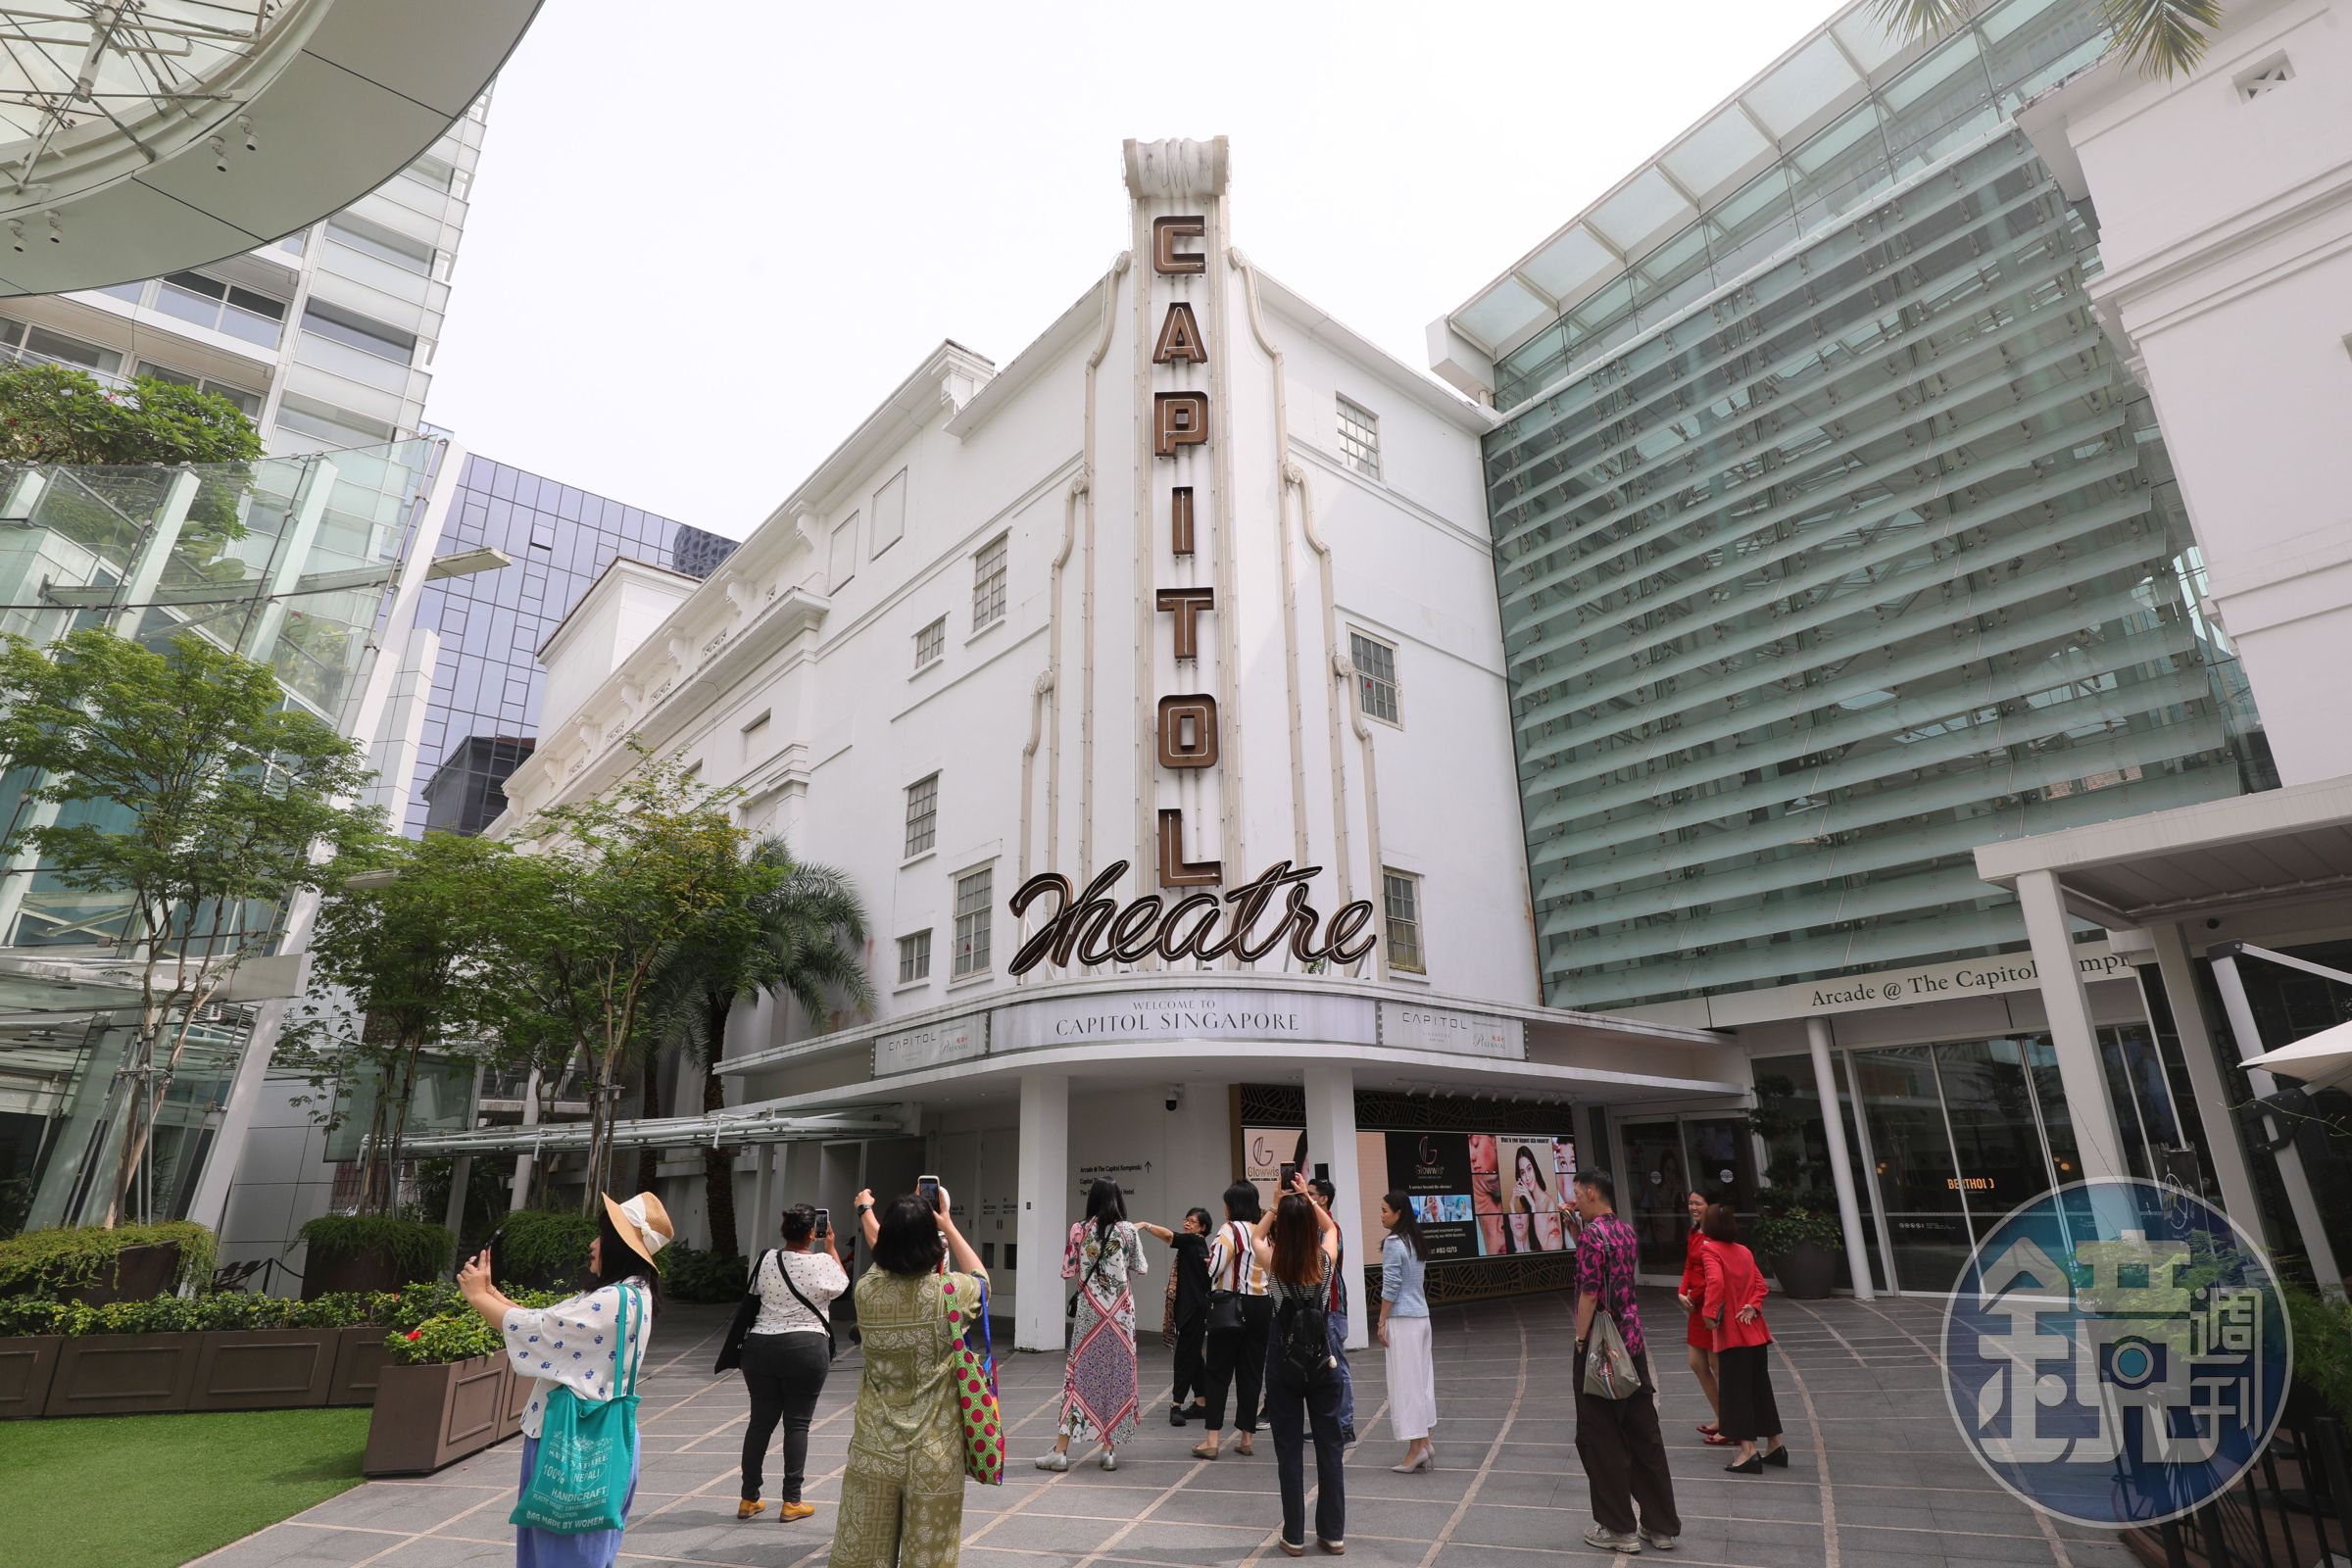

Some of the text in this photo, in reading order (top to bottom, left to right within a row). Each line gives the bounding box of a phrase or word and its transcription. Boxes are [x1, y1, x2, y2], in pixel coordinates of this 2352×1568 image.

[1152, 215, 1222, 888] CAPITOL
[1008, 858, 1378, 977] Theatre
[1811, 959, 2039, 1007] Arcade @ The Capitol
[1133, 1000, 1216, 1011] WELCOME TO
[1055, 1012, 1299, 1037] CAPITOL SINGAPORE
[1402, 1011, 1467, 1030] CAPITOL
[888, 1033, 937, 1052] CAPITOL
[1247, 1166, 1280, 1177] Glowwis
[543, 1463, 565, 1485] 100%
[551, 1487, 608, 1502] HANDICRAFT
[541, 1515, 561, 1529] MADE
[562, 1520, 573, 1530] BY
[574, 1515, 605, 1529] WOMEN
